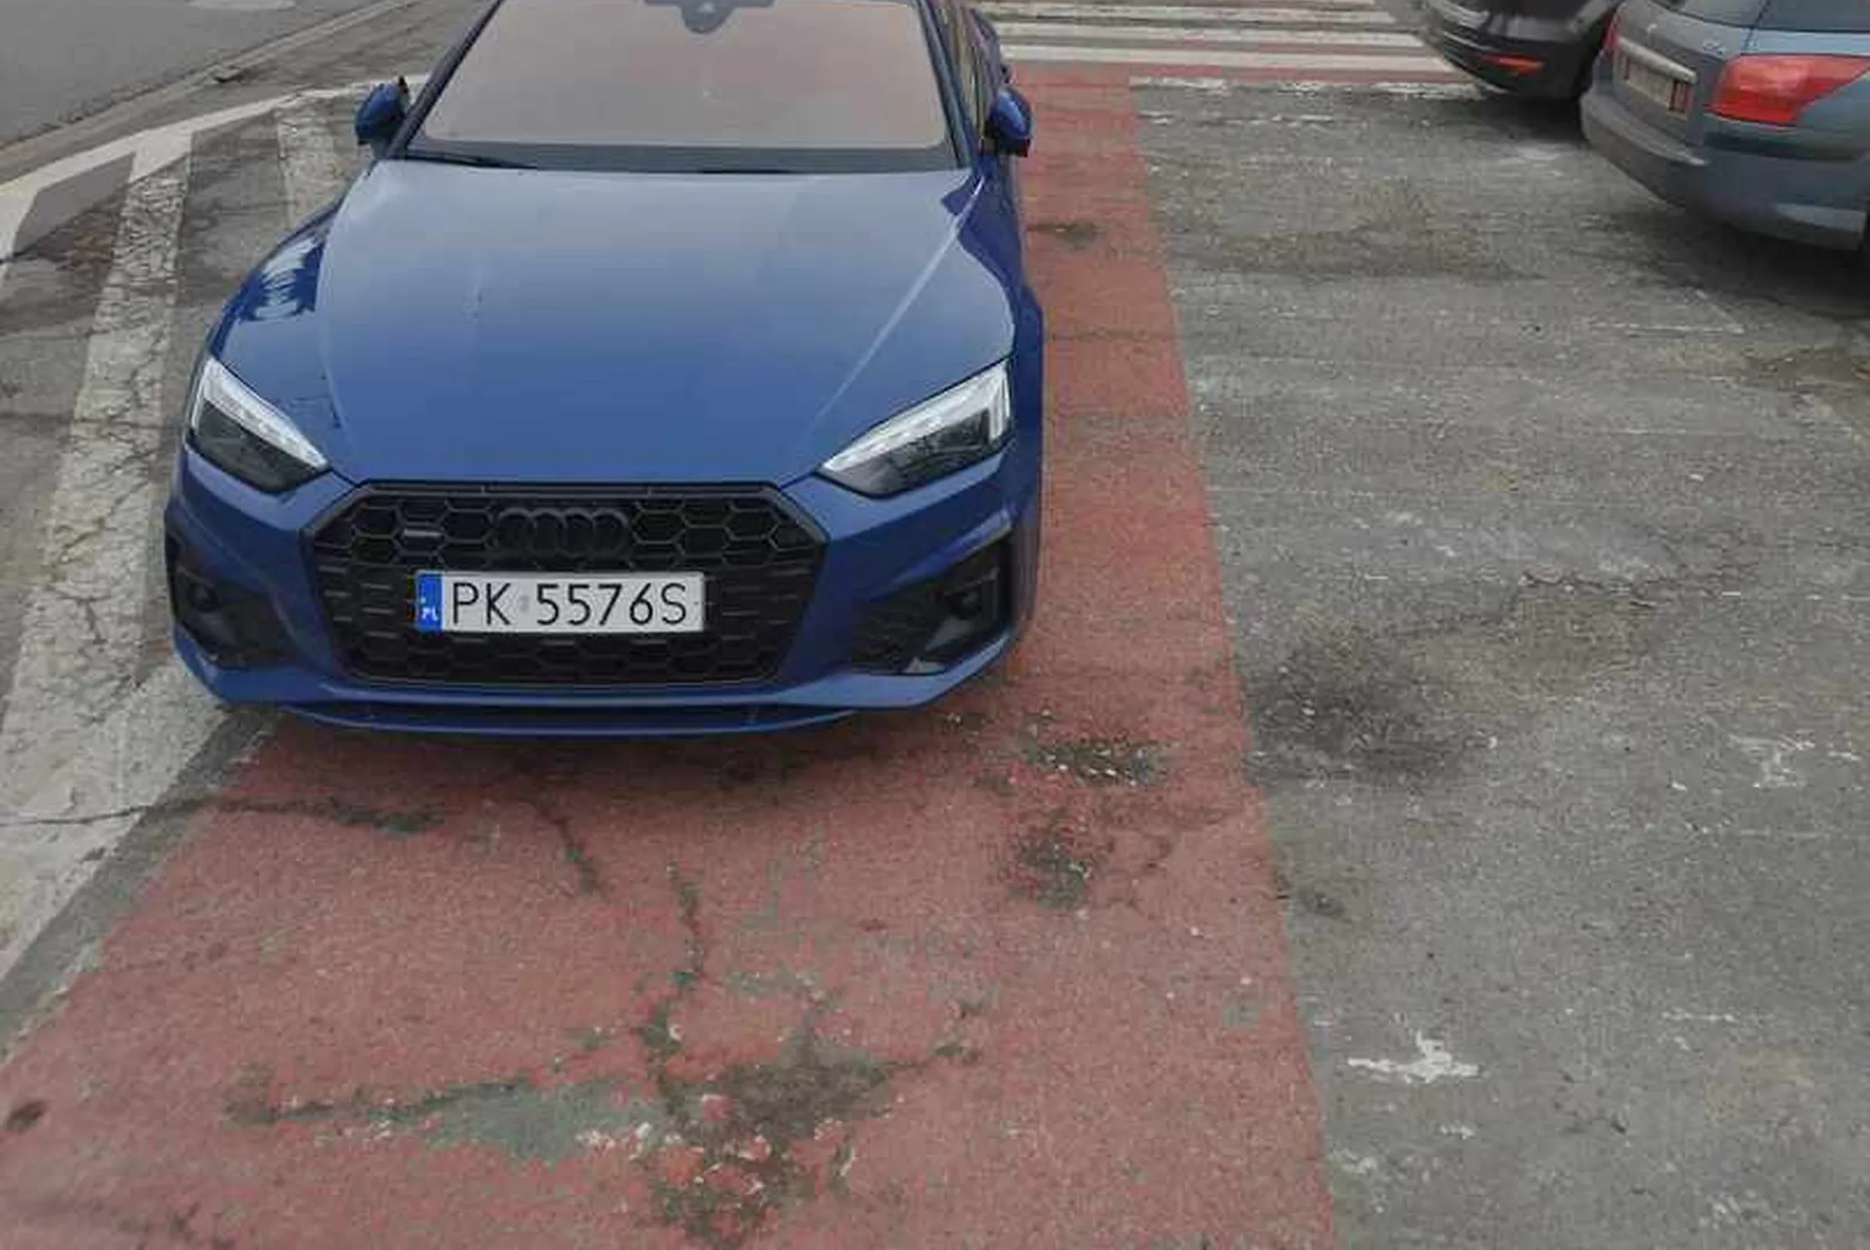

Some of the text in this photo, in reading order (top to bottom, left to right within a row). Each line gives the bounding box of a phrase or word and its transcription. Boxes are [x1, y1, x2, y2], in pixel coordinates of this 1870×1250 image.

[422, 607, 439, 622] PL
[453, 582, 687, 626] PK 5576S
